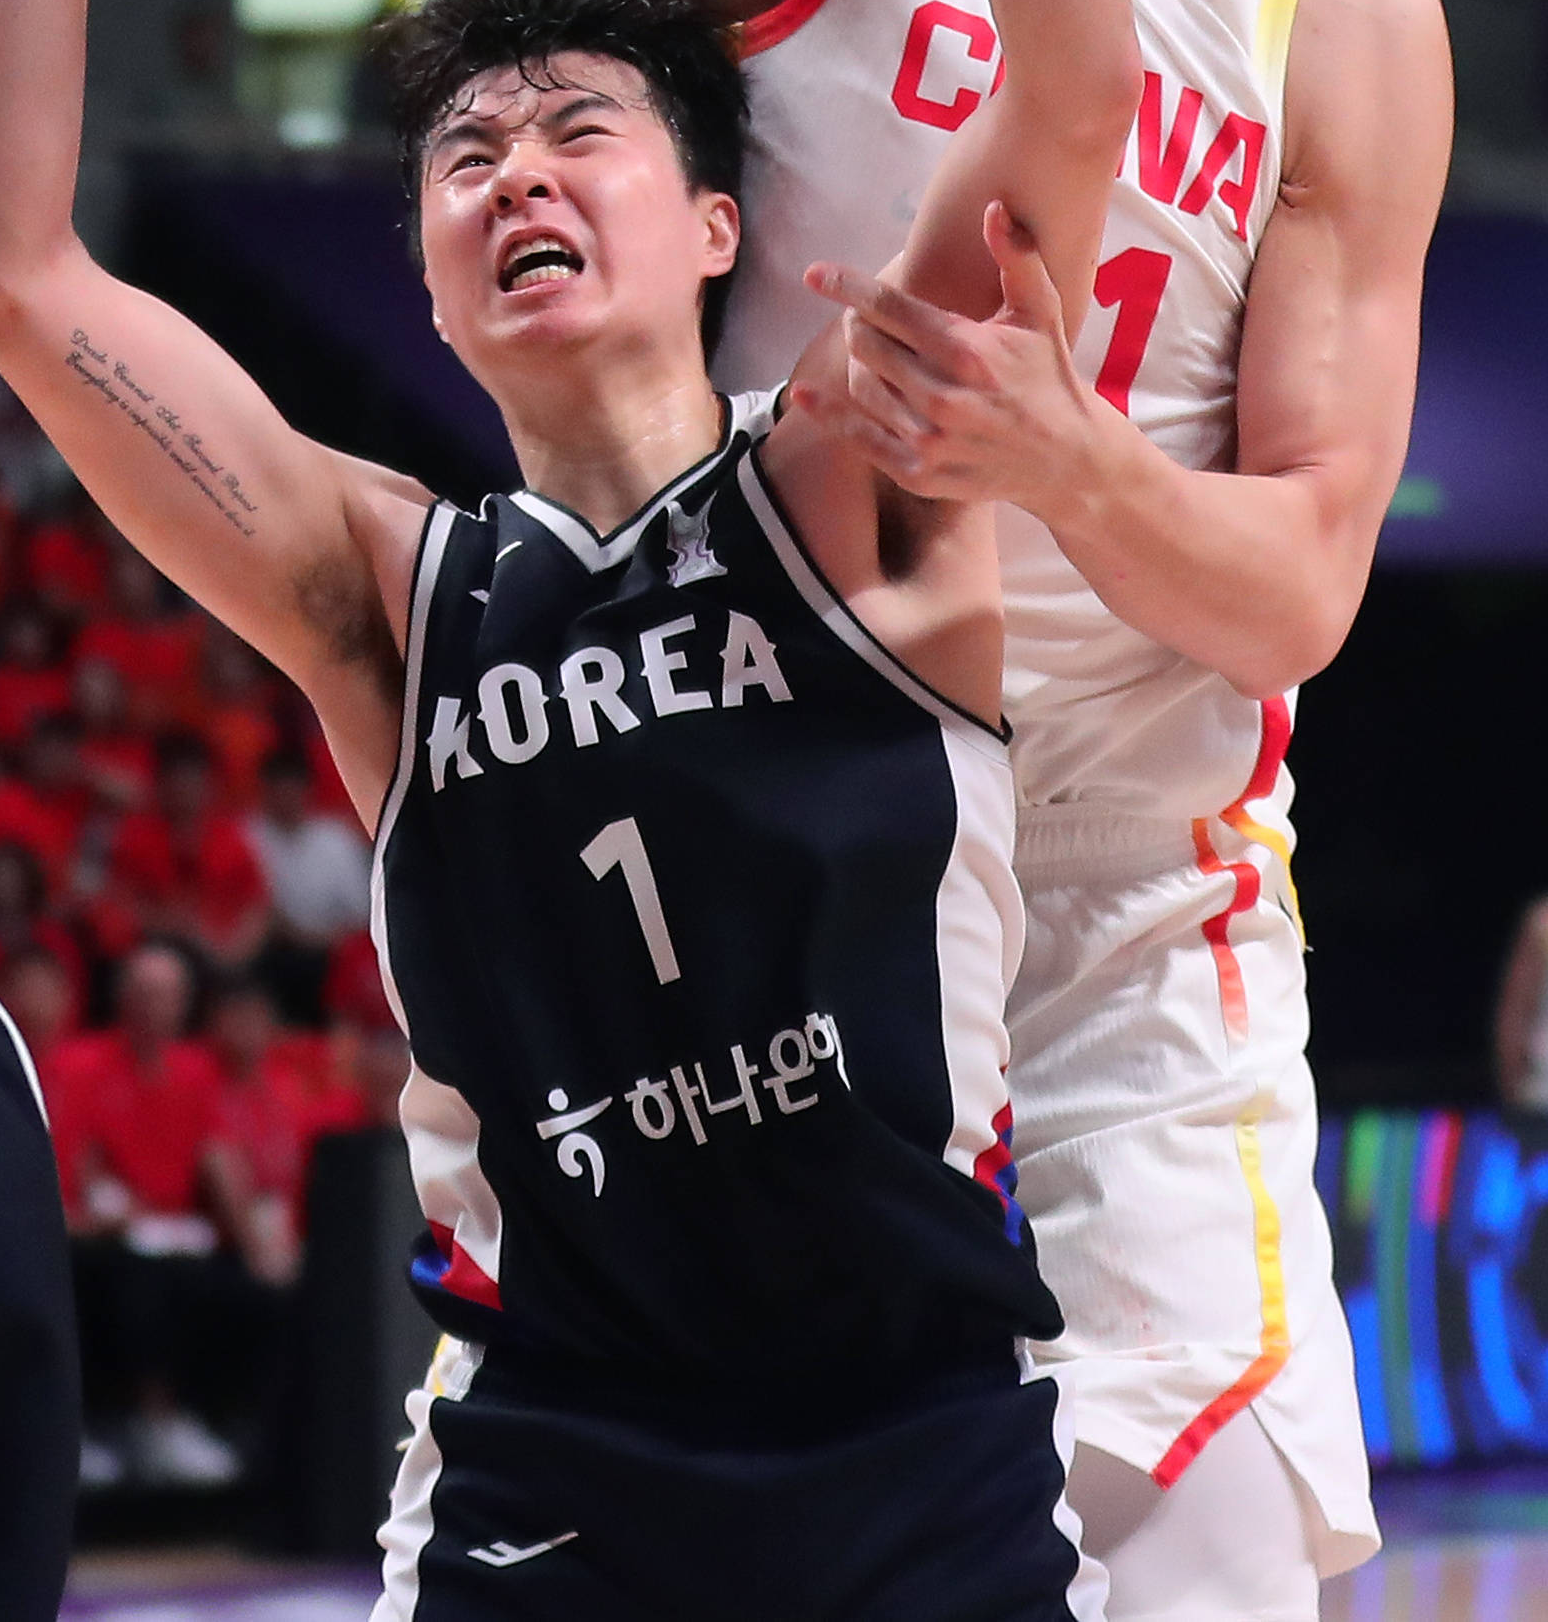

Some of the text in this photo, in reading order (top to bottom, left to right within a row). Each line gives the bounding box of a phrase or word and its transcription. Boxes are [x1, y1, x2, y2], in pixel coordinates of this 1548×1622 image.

[891, 0, 1266, 243] CNA
[426, 608, 794, 793] KOREA
[579, 815, 682, 986] 1
